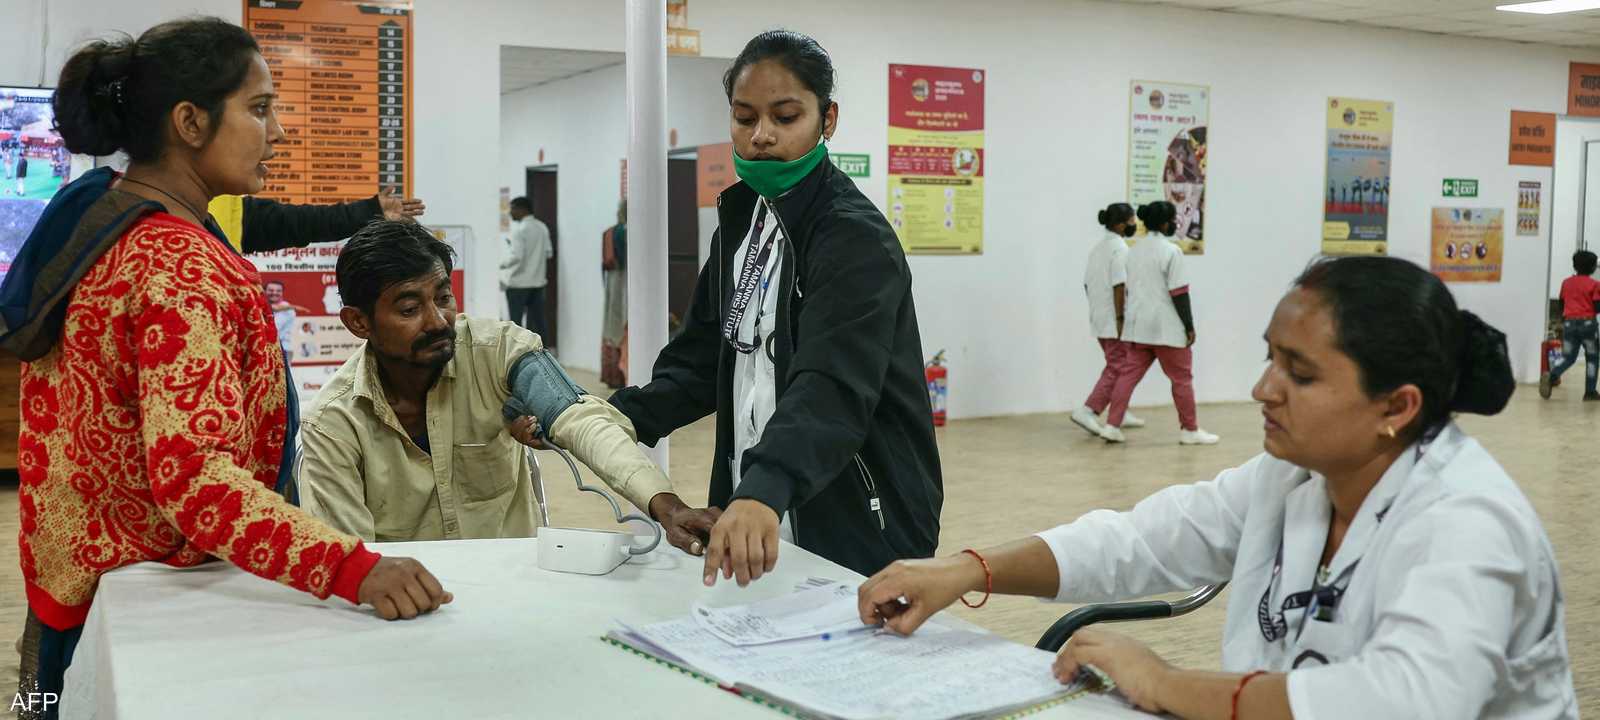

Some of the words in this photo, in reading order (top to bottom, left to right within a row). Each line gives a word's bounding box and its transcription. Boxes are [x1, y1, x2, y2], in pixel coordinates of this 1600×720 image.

[311, 128, 341, 136] PATHOLOGY
[840, 162, 866, 173] EXIT
[1460, 186, 1476, 194] EXIT
[282, 247, 316, 260] उन्मूलन
[320, 243, 340, 256] कार्य
[740, 243, 759, 289] TAMANNA
[740, 264, 764, 309] TAMANNA
[724, 292, 743, 339] INSTITUTE
